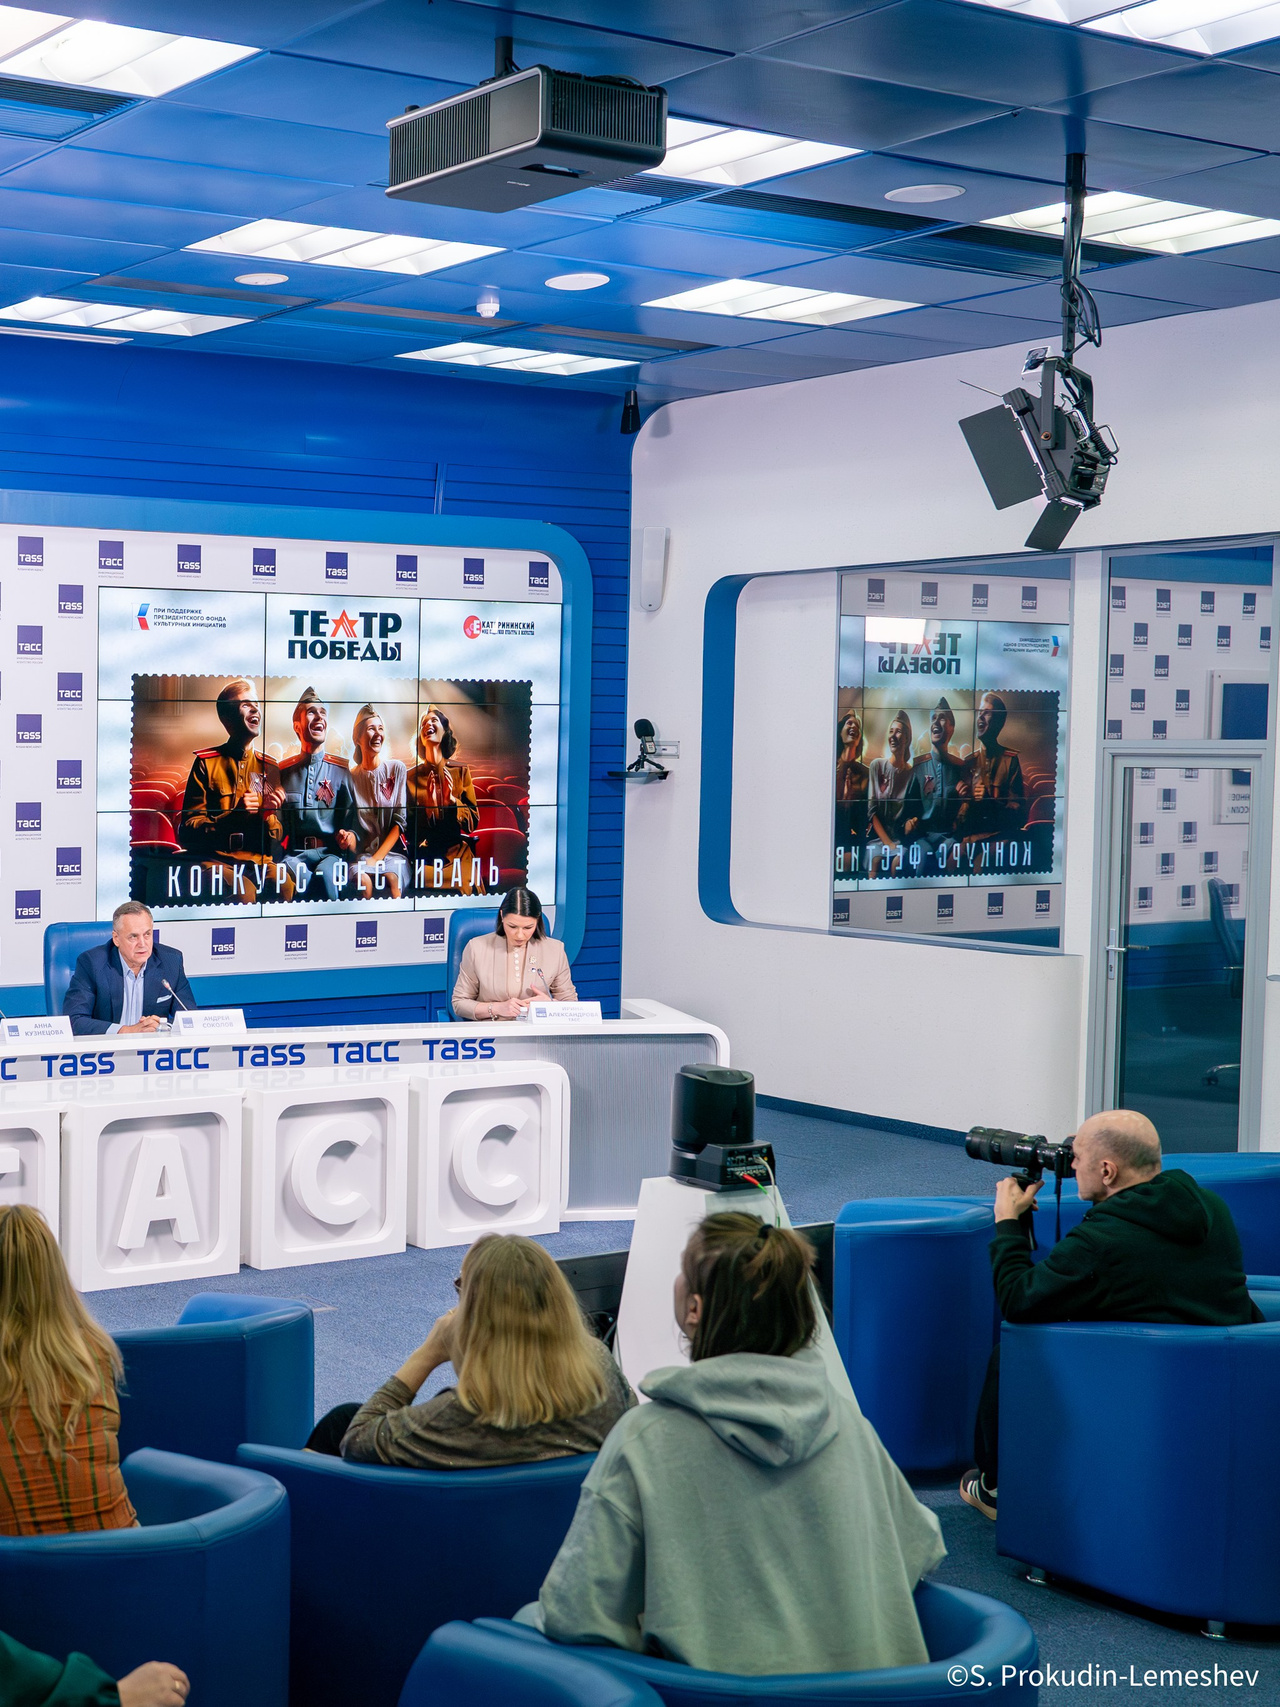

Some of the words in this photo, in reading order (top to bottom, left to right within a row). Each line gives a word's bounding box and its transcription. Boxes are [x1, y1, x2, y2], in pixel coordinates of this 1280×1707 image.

[290, 609, 402, 639] ТЕАТР
[288, 639, 402, 662] ПОБЕДЫ
[168, 857, 499, 898] КОНКУРС-ФЕСТИВАЛЬ
[24, 1028, 64, 1037] КУЗНЕЦОВА
